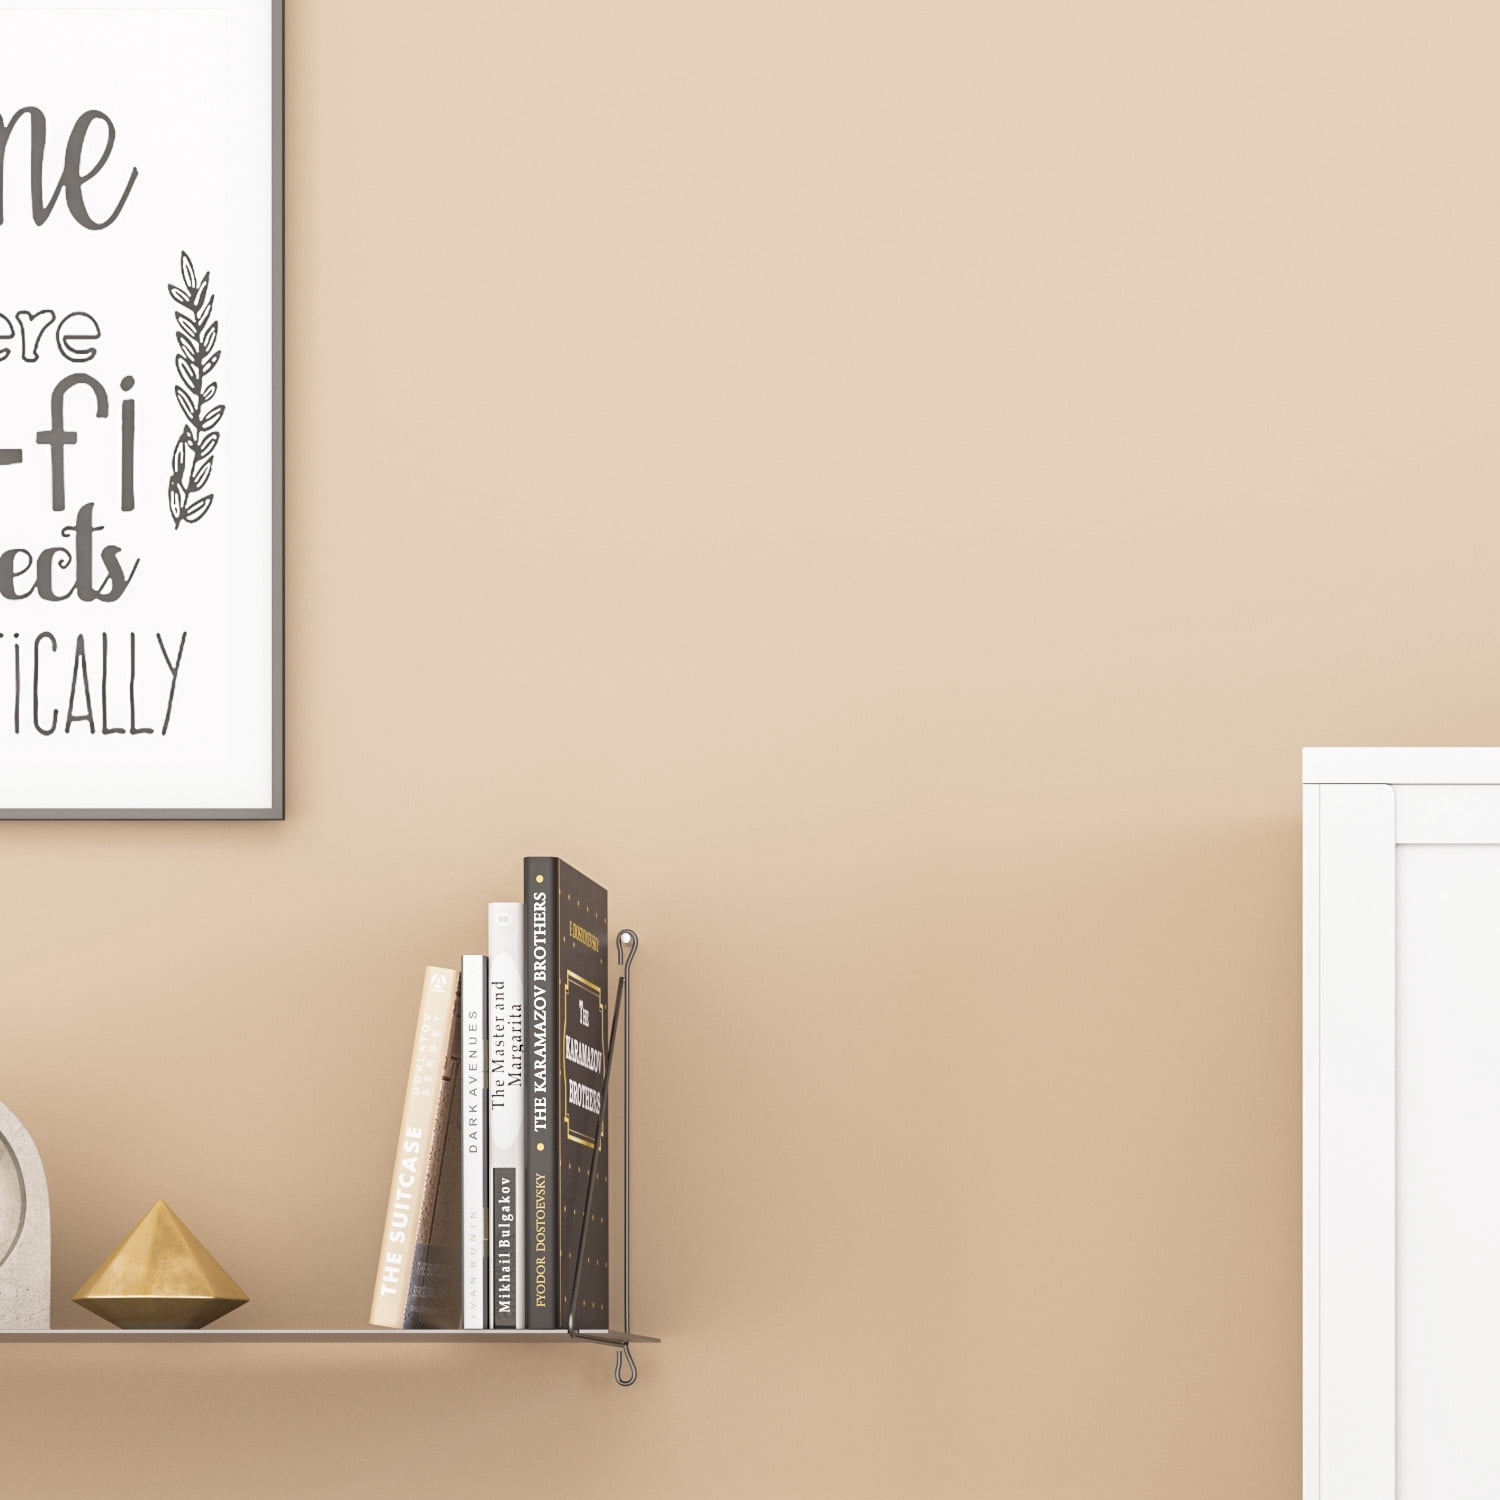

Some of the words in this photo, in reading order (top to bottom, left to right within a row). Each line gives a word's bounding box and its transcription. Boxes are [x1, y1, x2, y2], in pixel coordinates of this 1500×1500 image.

[0, 502, 140, 603] ects
[0, 631, 187, 736] iCALLY
[534, 891, 547, 982] BROTHERS
[491, 980, 505, 1010] and
[468, 1011, 478, 1097] AVENUES
[492, 1016, 505, 1074] Master
[508, 1003, 525, 1087] Margarita
[534, 985, 547, 1093] KARAMAZOV
[566, 1035, 602, 1075] KARAMAZOV
[492, 1080, 505, 1111] The
[534, 1096, 547, 1132] THE
[569, 1079, 601, 1115] BROTHERS
[468, 1110, 478, 1153] DARK
[389, 1126, 423, 1244] SUITCASE
[498, 1177, 514, 1248] Bulgakov
[536, 1173, 546, 1252] DOSTOEVSKY
[381, 1252, 403, 1296] THE
[498, 1253, 511, 1313] Mikhail
[536, 1256, 546, 1307] FYODOR
